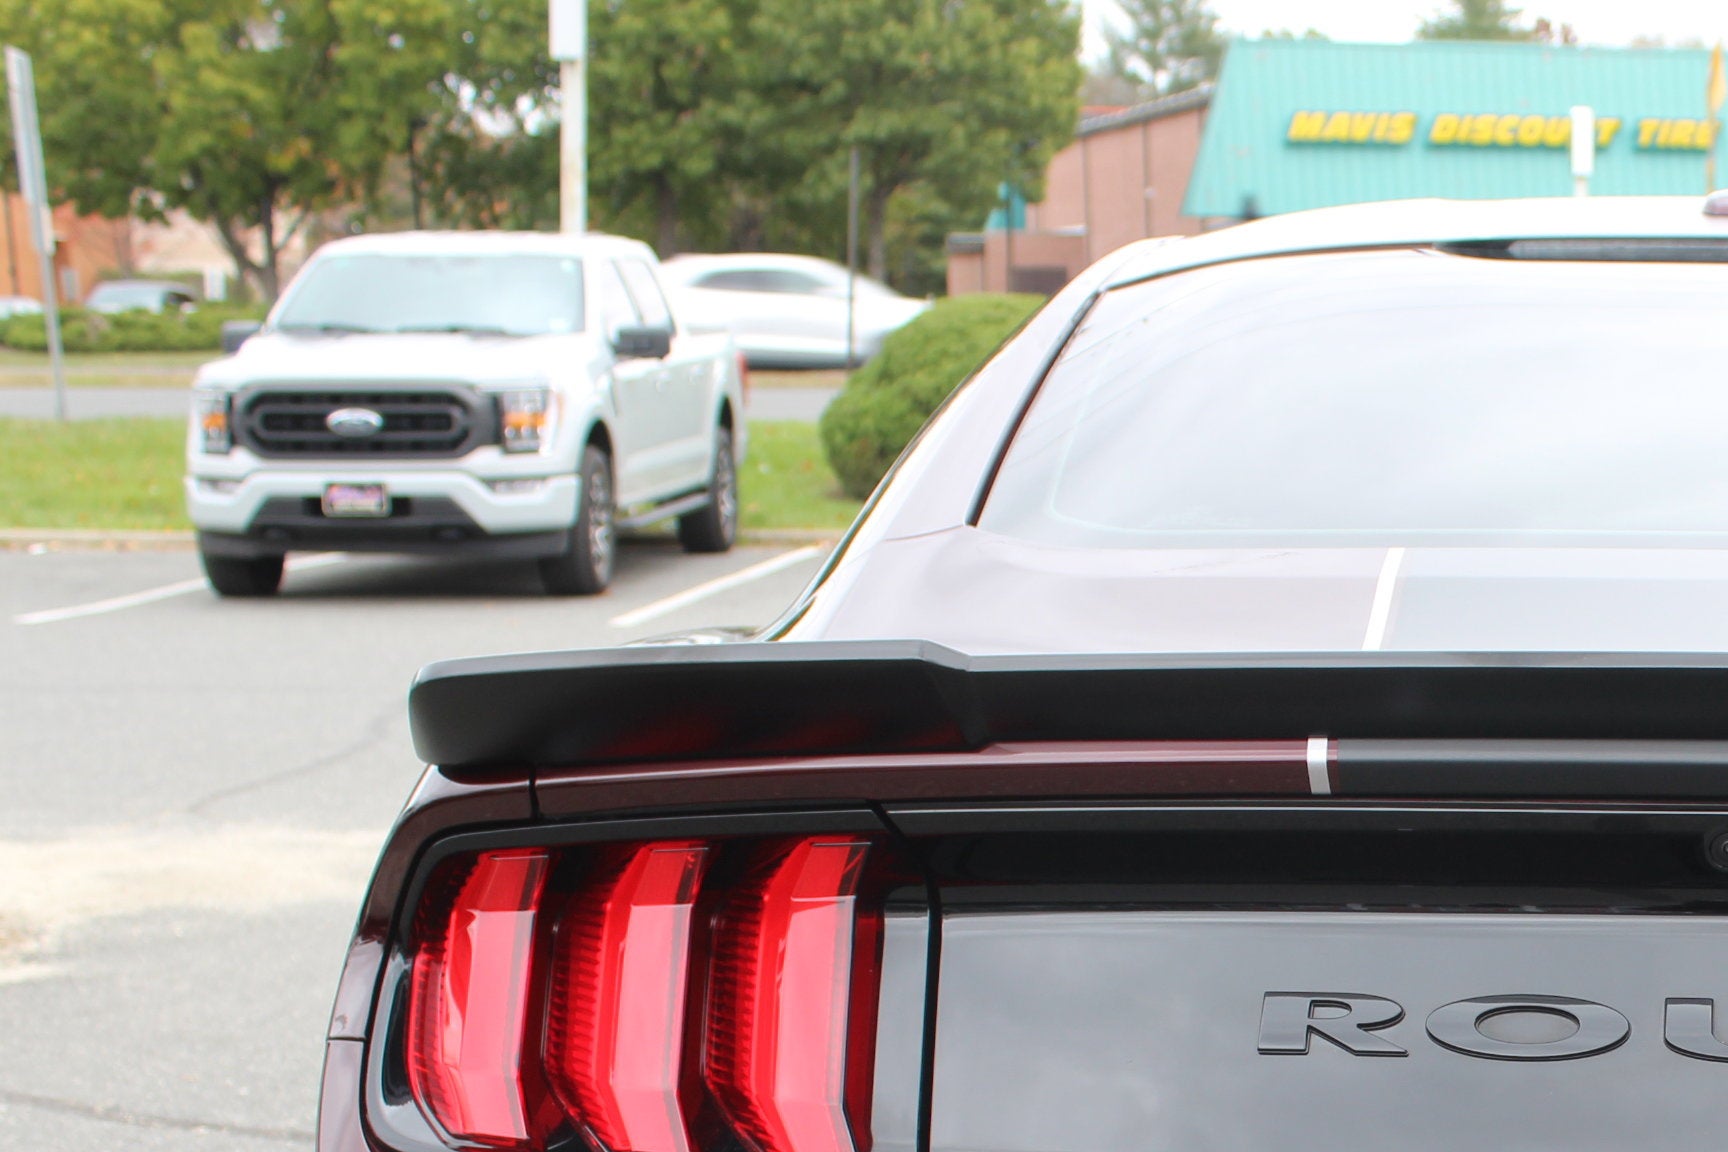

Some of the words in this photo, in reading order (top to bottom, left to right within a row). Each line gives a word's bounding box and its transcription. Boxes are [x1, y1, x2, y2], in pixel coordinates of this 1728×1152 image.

[1287, 110, 1417, 143] MAVIS
[1429, 113, 1622, 148] DISCOUT
[1637, 118, 1720, 149] TIRE
